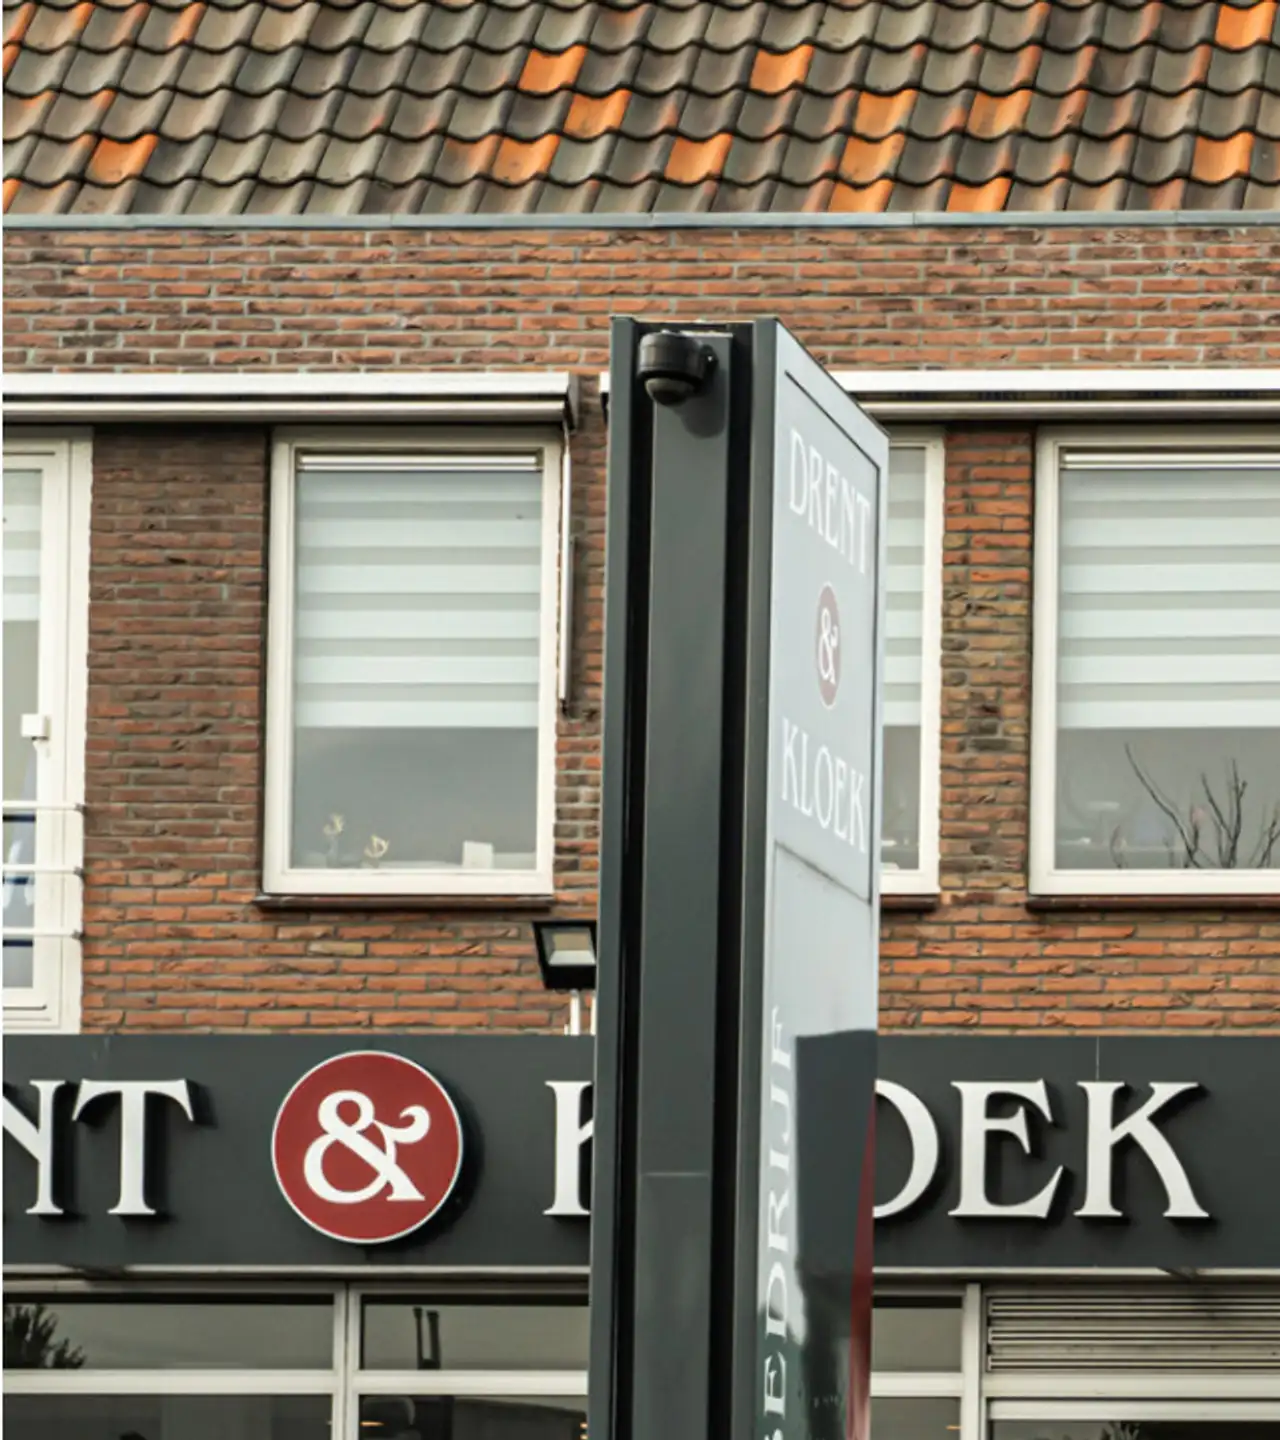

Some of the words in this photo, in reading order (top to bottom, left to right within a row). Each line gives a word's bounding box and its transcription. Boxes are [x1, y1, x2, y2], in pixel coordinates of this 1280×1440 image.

[788, 428, 871, 575] DRENT
[817, 606, 839, 685] &
[781, 716, 867, 854] KLOEK
[303, 1089, 430, 1204] &
